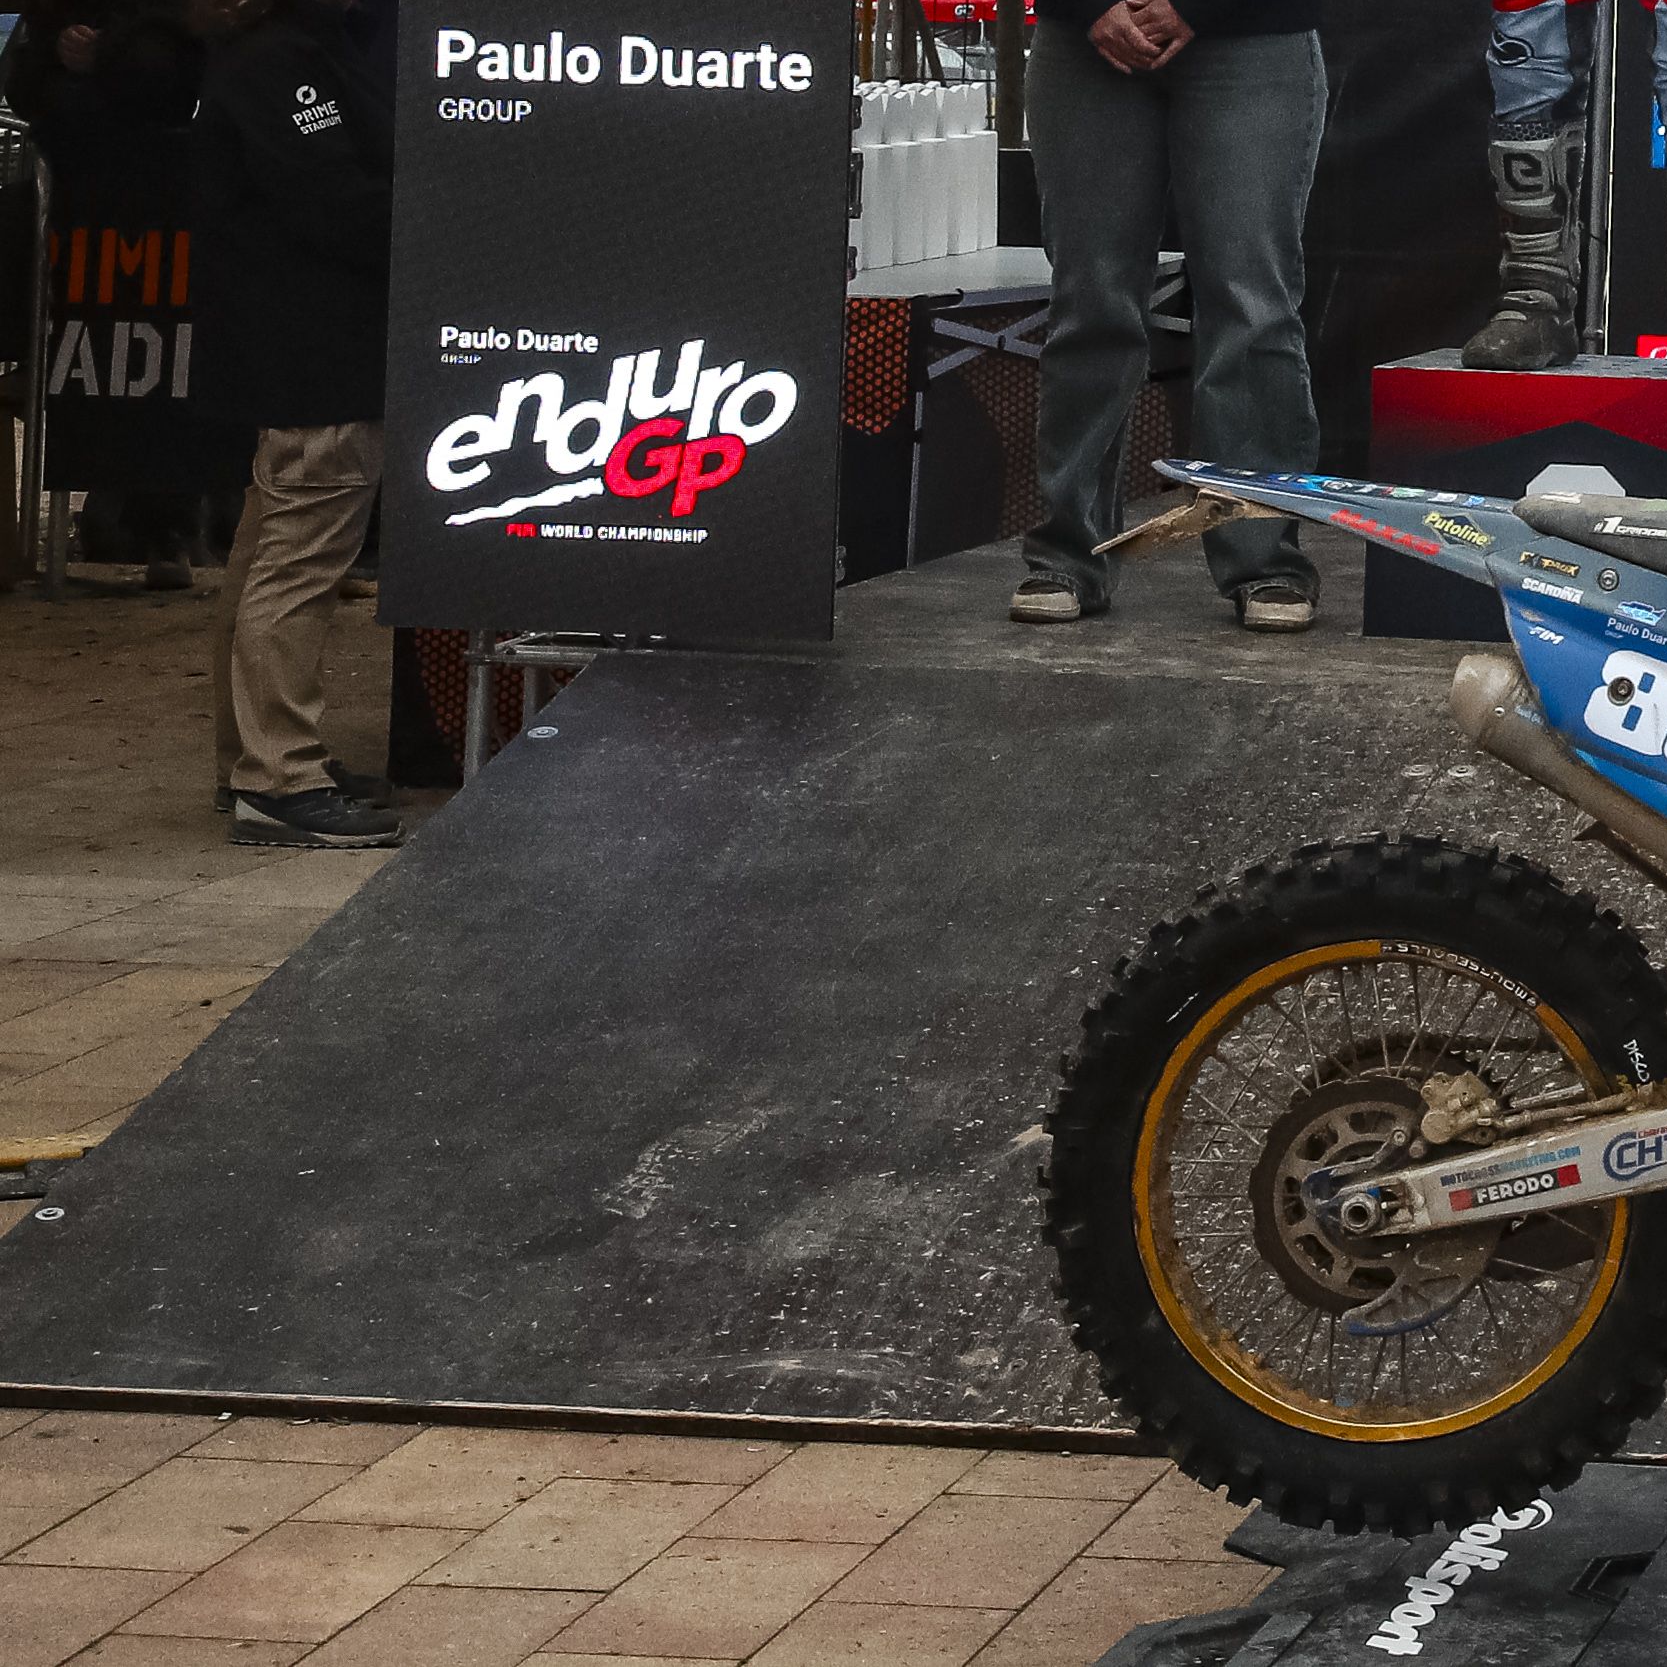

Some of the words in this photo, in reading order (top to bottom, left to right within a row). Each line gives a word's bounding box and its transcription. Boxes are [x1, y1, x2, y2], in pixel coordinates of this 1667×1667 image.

[435, 29, 601, 85] Paulo
[619, 34, 813, 92] Duarte
[292, 101, 339, 125] PRIME
[438, 97, 533, 123] GROUP
[300, 114, 342, 134] STADIUM
[440, 326, 511, 350] Paulo
[516, 329, 599, 354] Duarte
[604, 417, 747, 517] GP
[1423, 511, 1490, 547] Putoline
[1529, 626, 1564, 645] FIM
[1607, 617, 1640, 636] Paulo
[1475, 1173, 1555, 1205] FERODO
